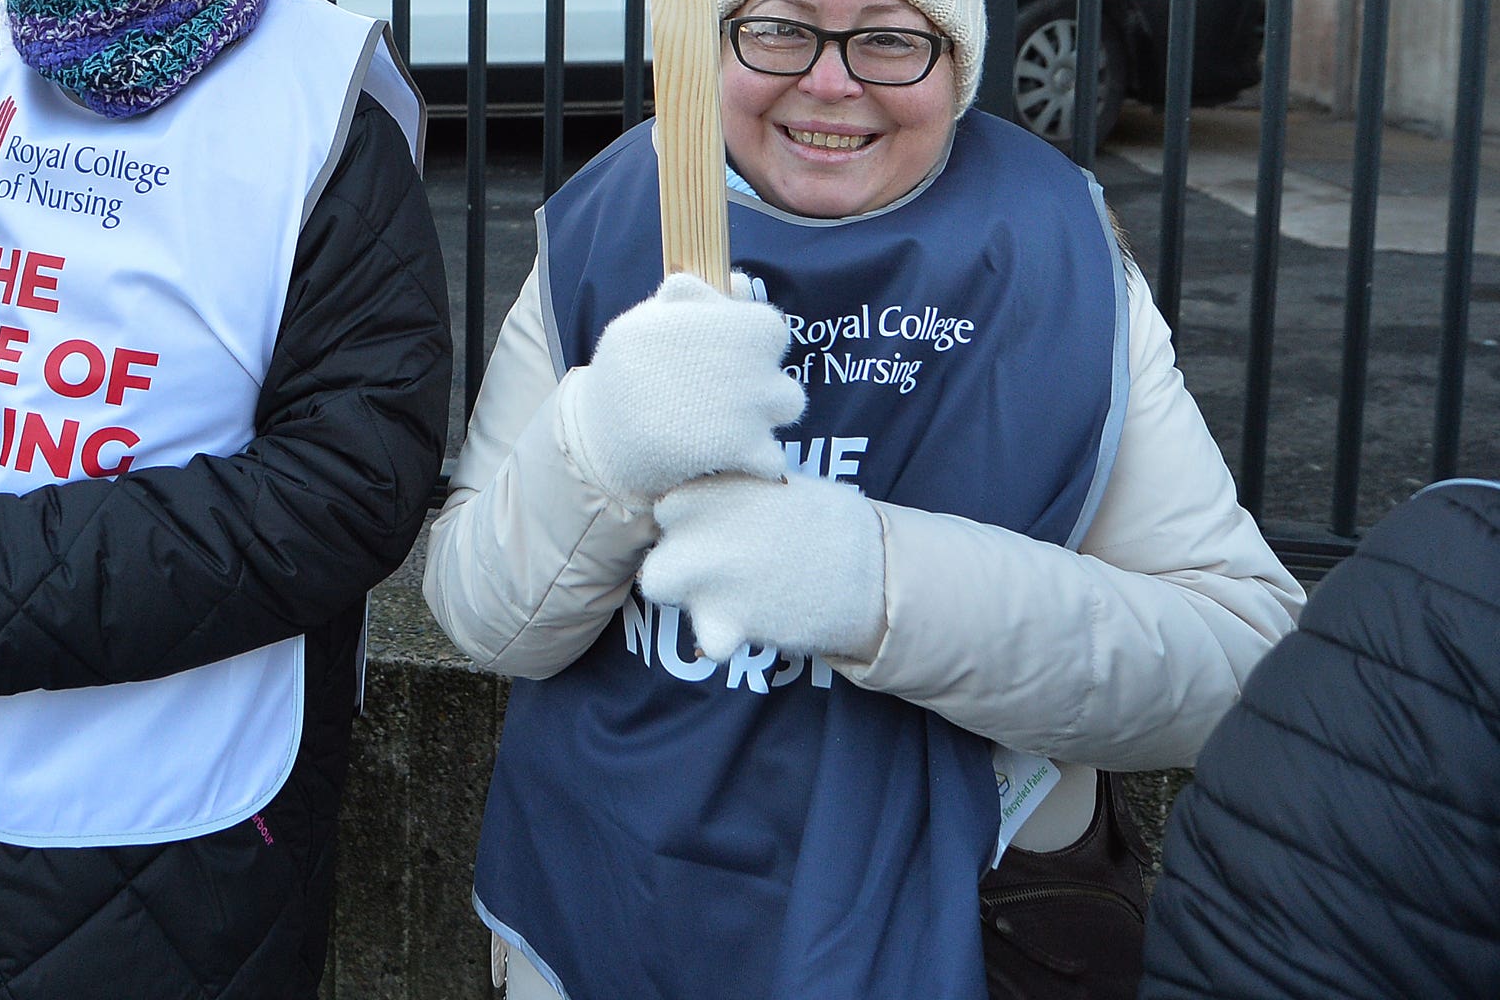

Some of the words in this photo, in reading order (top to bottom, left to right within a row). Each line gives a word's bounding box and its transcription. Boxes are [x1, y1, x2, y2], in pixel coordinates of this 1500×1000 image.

[5, 135, 71, 173] Royal
[73, 146, 171, 193] College
[26, 178, 123, 229] Nursing
[785, 304, 870, 352] Royal
[878, 306, 975, 351] College
[44, 339, 159, 407] OF
[824, 352, 923, 394] Nursing
[779, 436, 869, 494] HE
[1002, 784, 1031, 818] Recycled
[1027, 766, 1048, 788] Fabric
